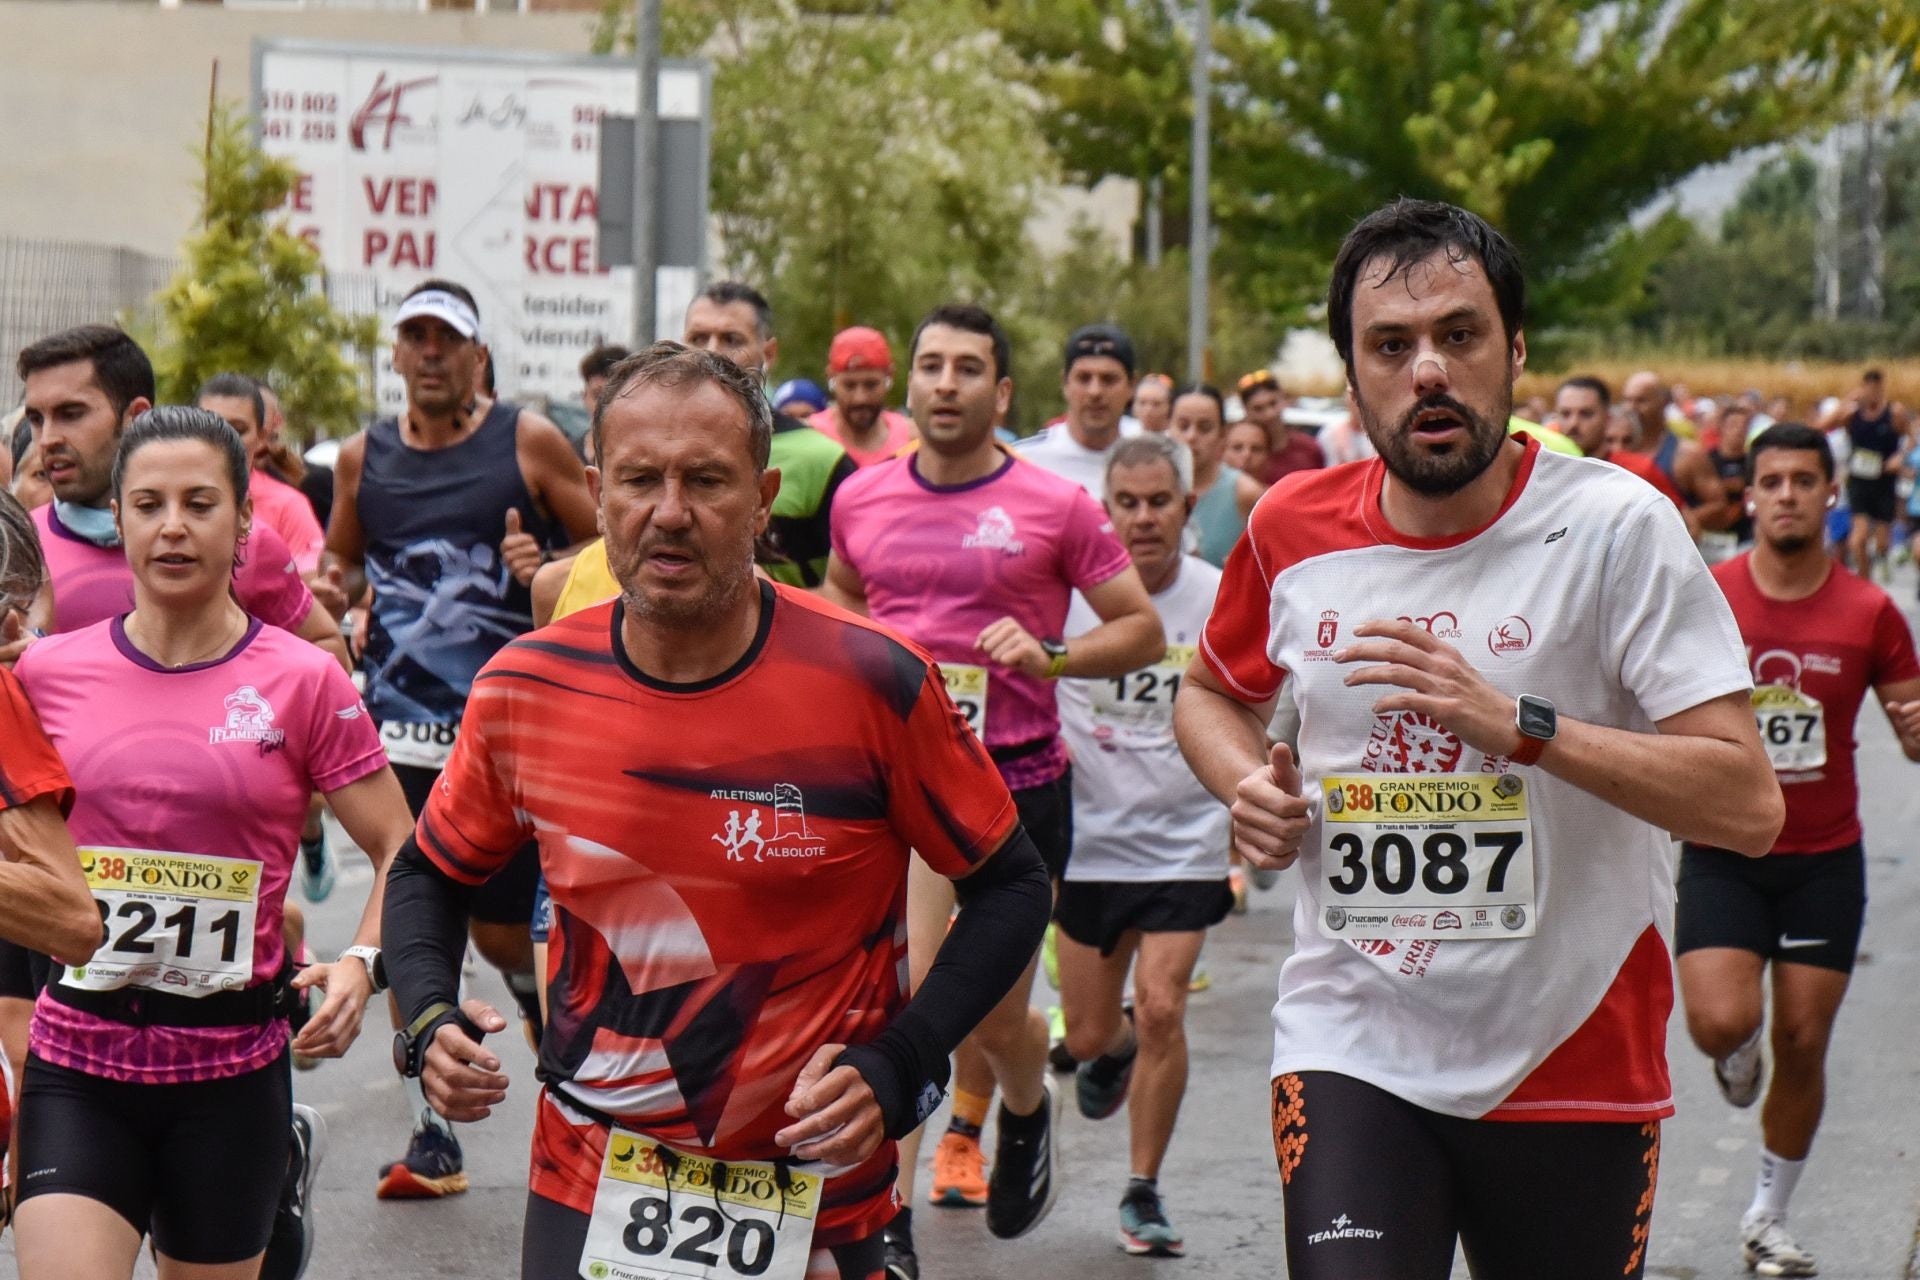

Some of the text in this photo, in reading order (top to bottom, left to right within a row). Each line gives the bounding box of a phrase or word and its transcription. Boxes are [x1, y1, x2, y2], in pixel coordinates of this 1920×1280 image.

[1757, 714, 1819, 745] 67
[710, 789, 774, 802] ATLETISMO
[1346, 784, 1374, 811] 38
[1379, 782, 1415, 792] GRAN
[1419, 781, 1470, 791] PREMIO
[1374, 791, 1482, 813] FONDO
[766, 846, 826, 858] ALBOLOTE
[1328, 831, 1524, 895] 3087
[97, 856, 126, 880] 38
[132, 857, 166, 868] GRAN
[169, 860, 215, 872] PREMIO
[126, 865, 222, 891] FONDO
[1347, 913, 1389, 924] Cruzcampo
[1399, 938, 1426, 975] URB
[727, 1166, 768, 1179] REMIO
[622, 1196, 775, 1276] 820
[1307, 1228, 1384, 1245] TEAMERGY
